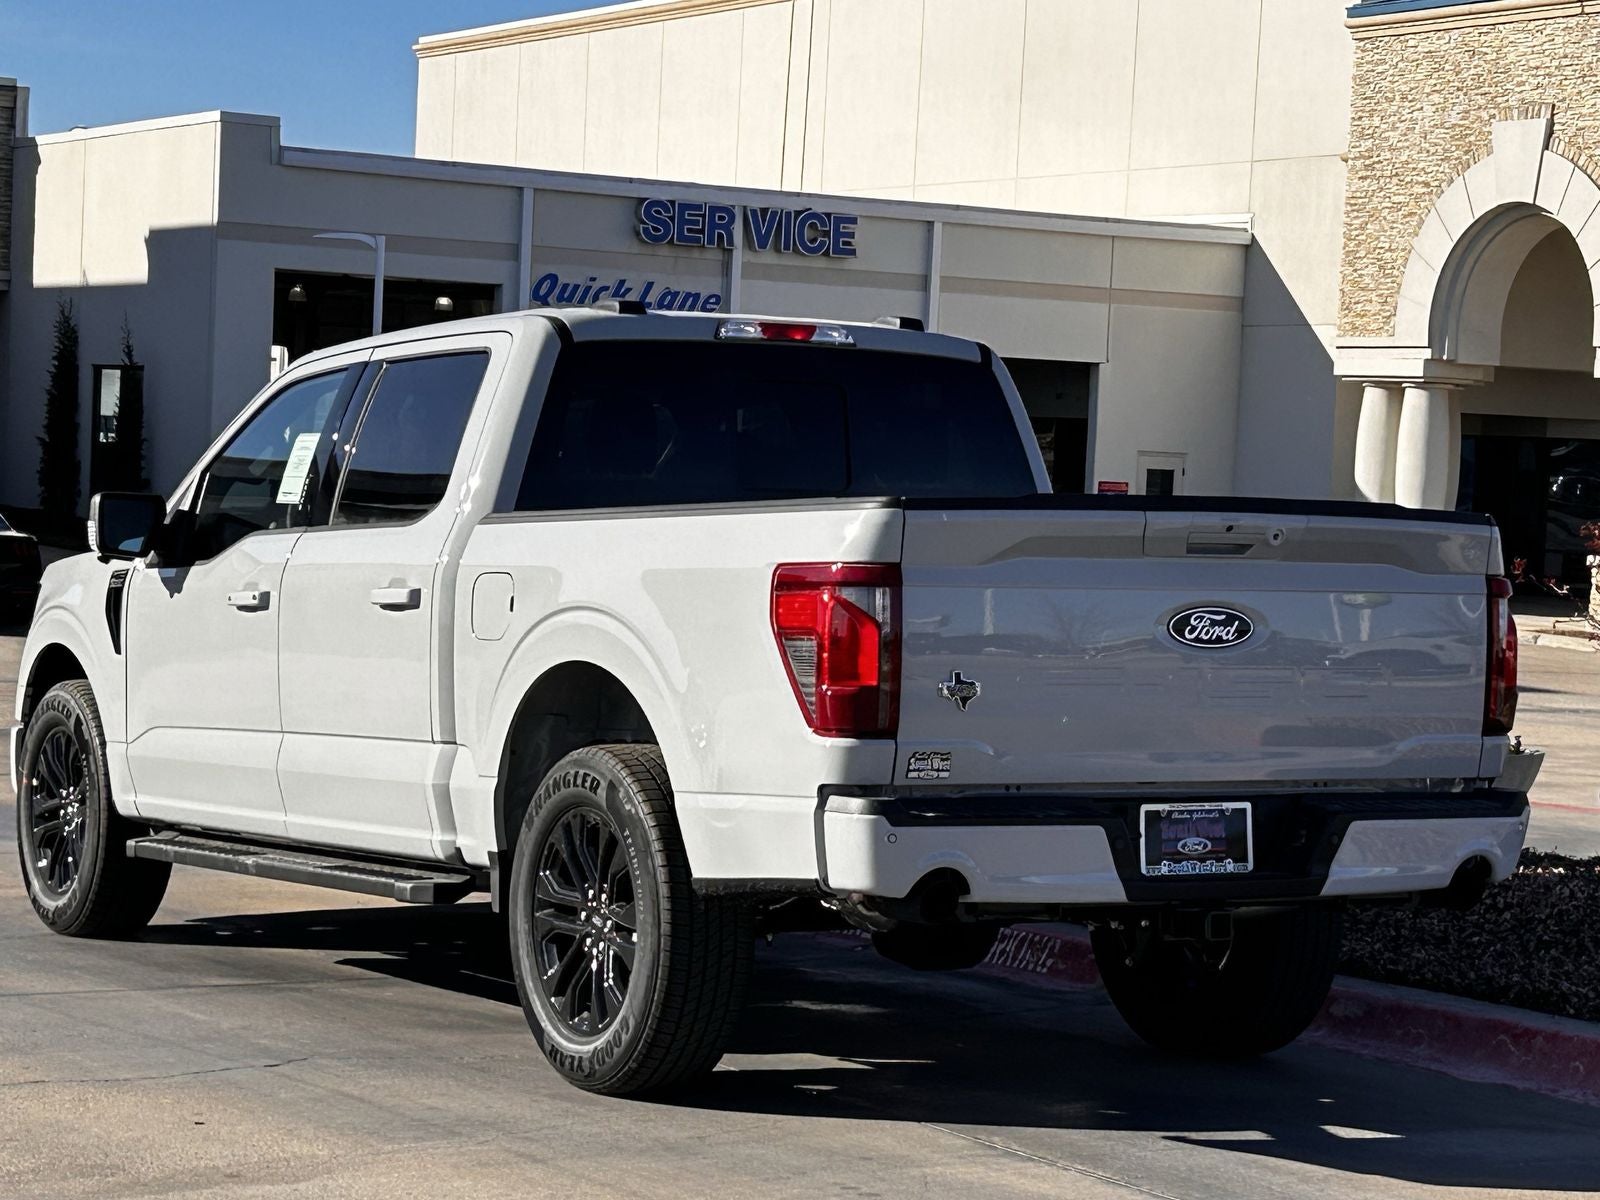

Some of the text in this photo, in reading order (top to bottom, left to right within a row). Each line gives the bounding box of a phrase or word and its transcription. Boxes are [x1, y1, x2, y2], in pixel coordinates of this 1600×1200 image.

[639, 198, 859, 258] SERVICE
[531, 272, 722, 313] Quick Lane
[1184, 612, 1239, 640] Ford
[524, 769, 602, 833] WRANGLER
